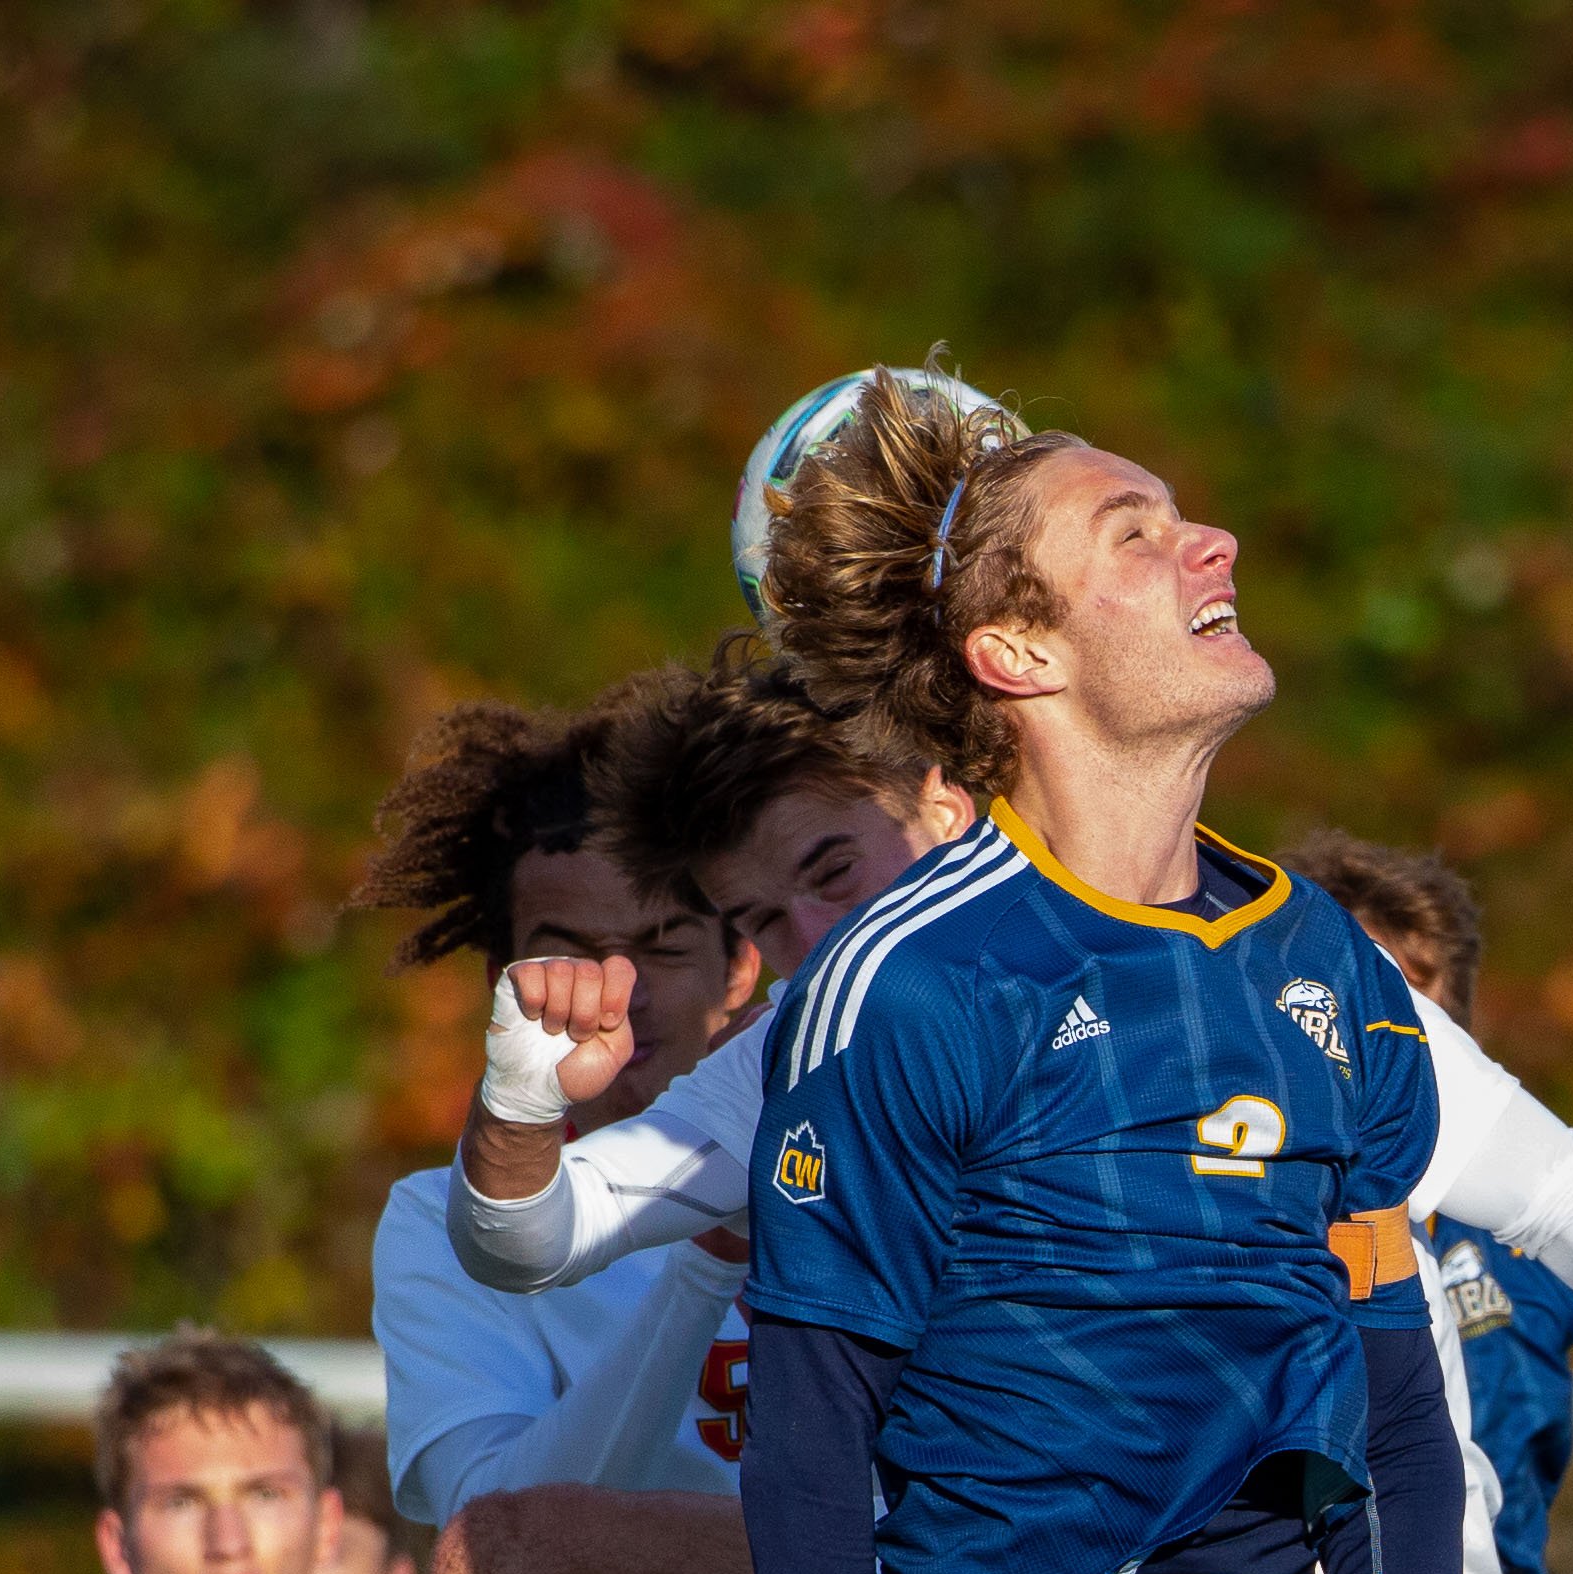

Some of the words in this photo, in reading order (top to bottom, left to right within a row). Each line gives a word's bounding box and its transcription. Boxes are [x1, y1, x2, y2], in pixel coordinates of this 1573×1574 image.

[1052, 1020, 1111, 1050] adidas
[1191, 1094, 1286, 1178] 2
[781, 1148, 821, 1191] CW
[696, 1339, 749, 1462] 5
